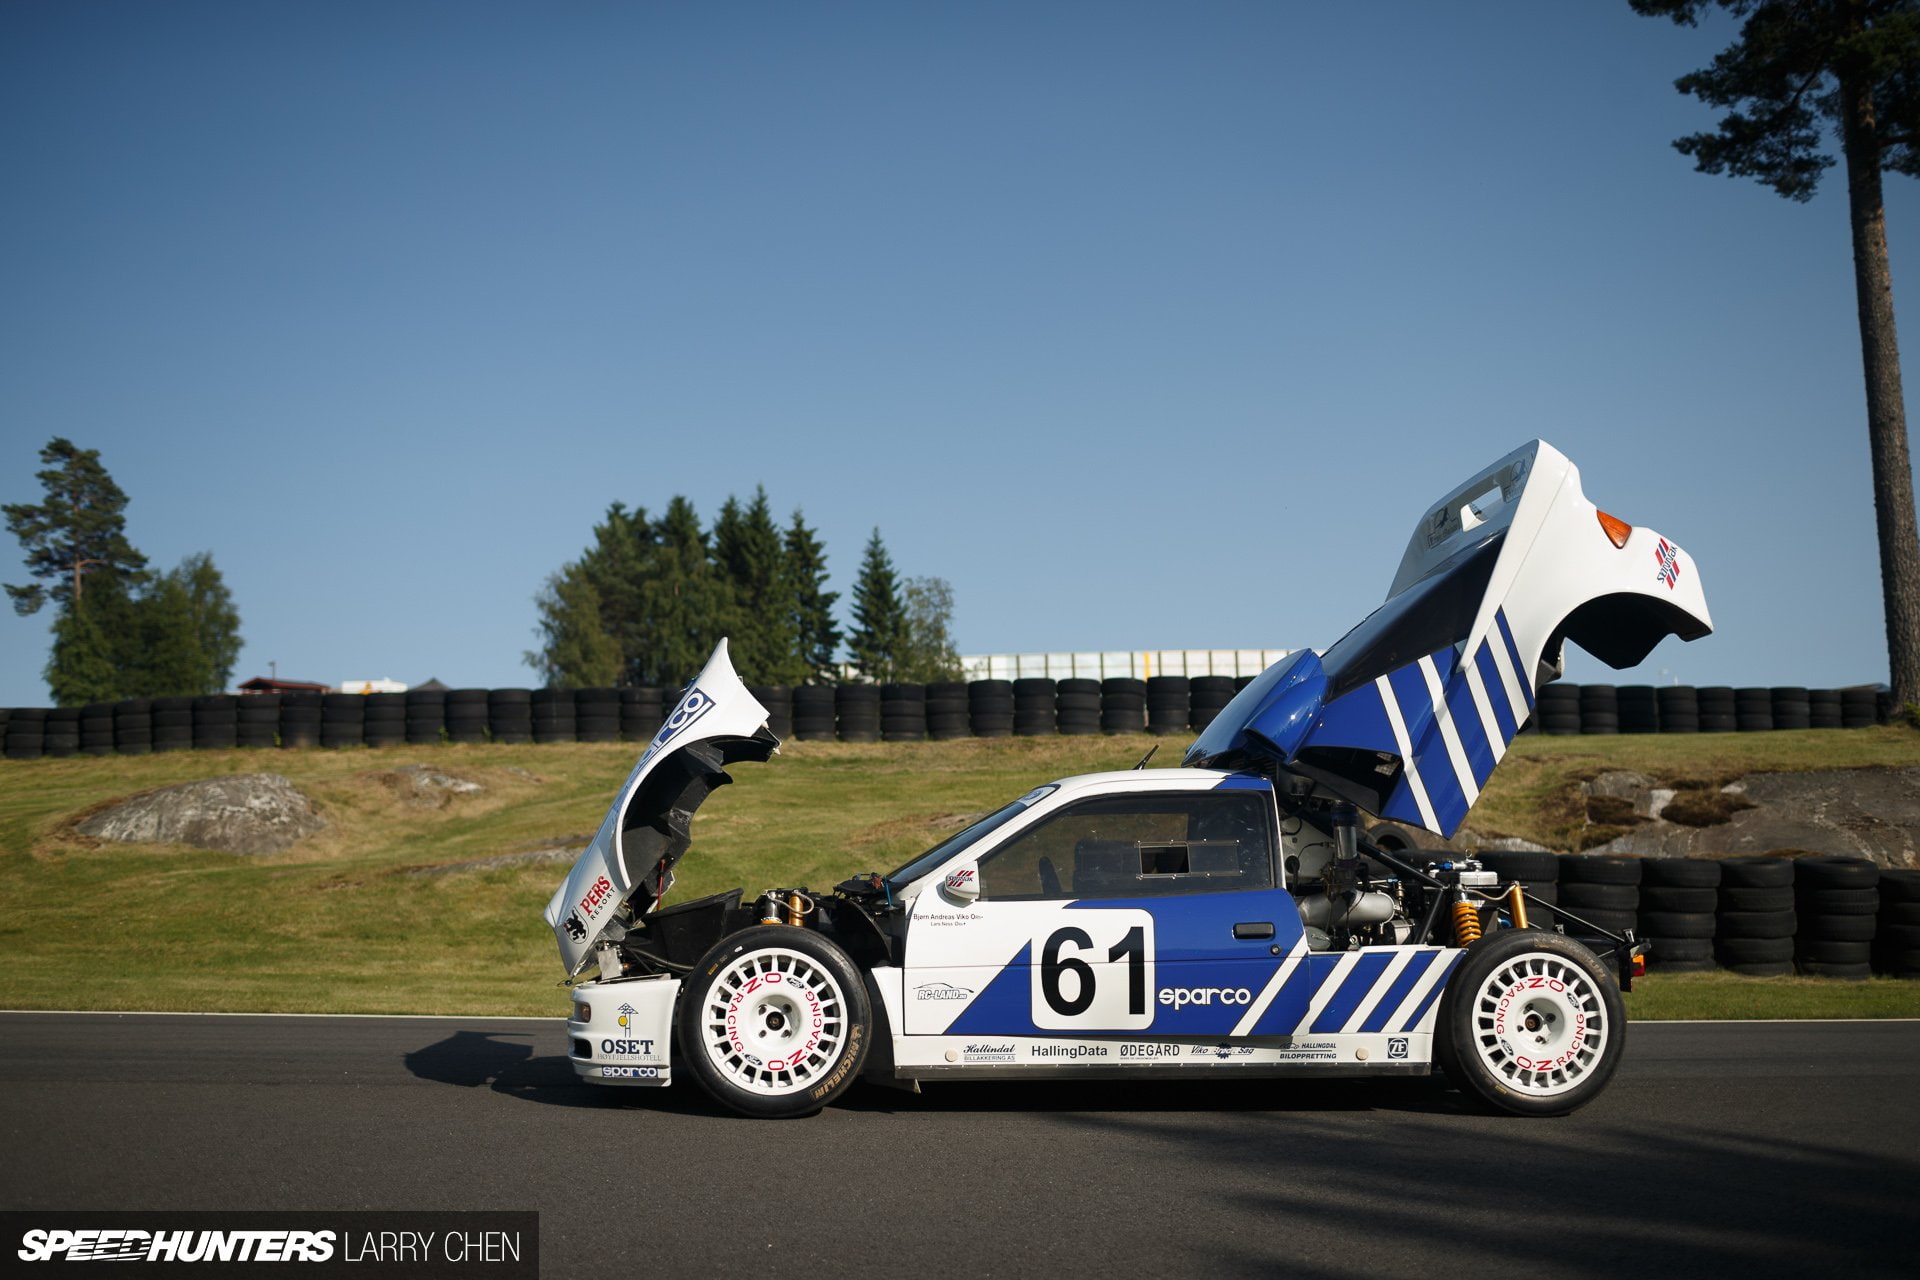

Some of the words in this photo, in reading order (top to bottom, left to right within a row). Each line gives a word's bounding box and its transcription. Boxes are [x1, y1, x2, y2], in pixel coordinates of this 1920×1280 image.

[580, 876, 610, 916] PERS
[590, 887, 615, 920] RESORT
[1041, 926, 1145, 1016] 61
[1159, 988, 1251, 1010] sparco
[601, 1039, 654, 1054] OSET
[1032, 1045, 1108, 1058] HallingData
[1390, 1041, 1406, 1055] ZF
[602, 1066, 657, 1077] sparco
